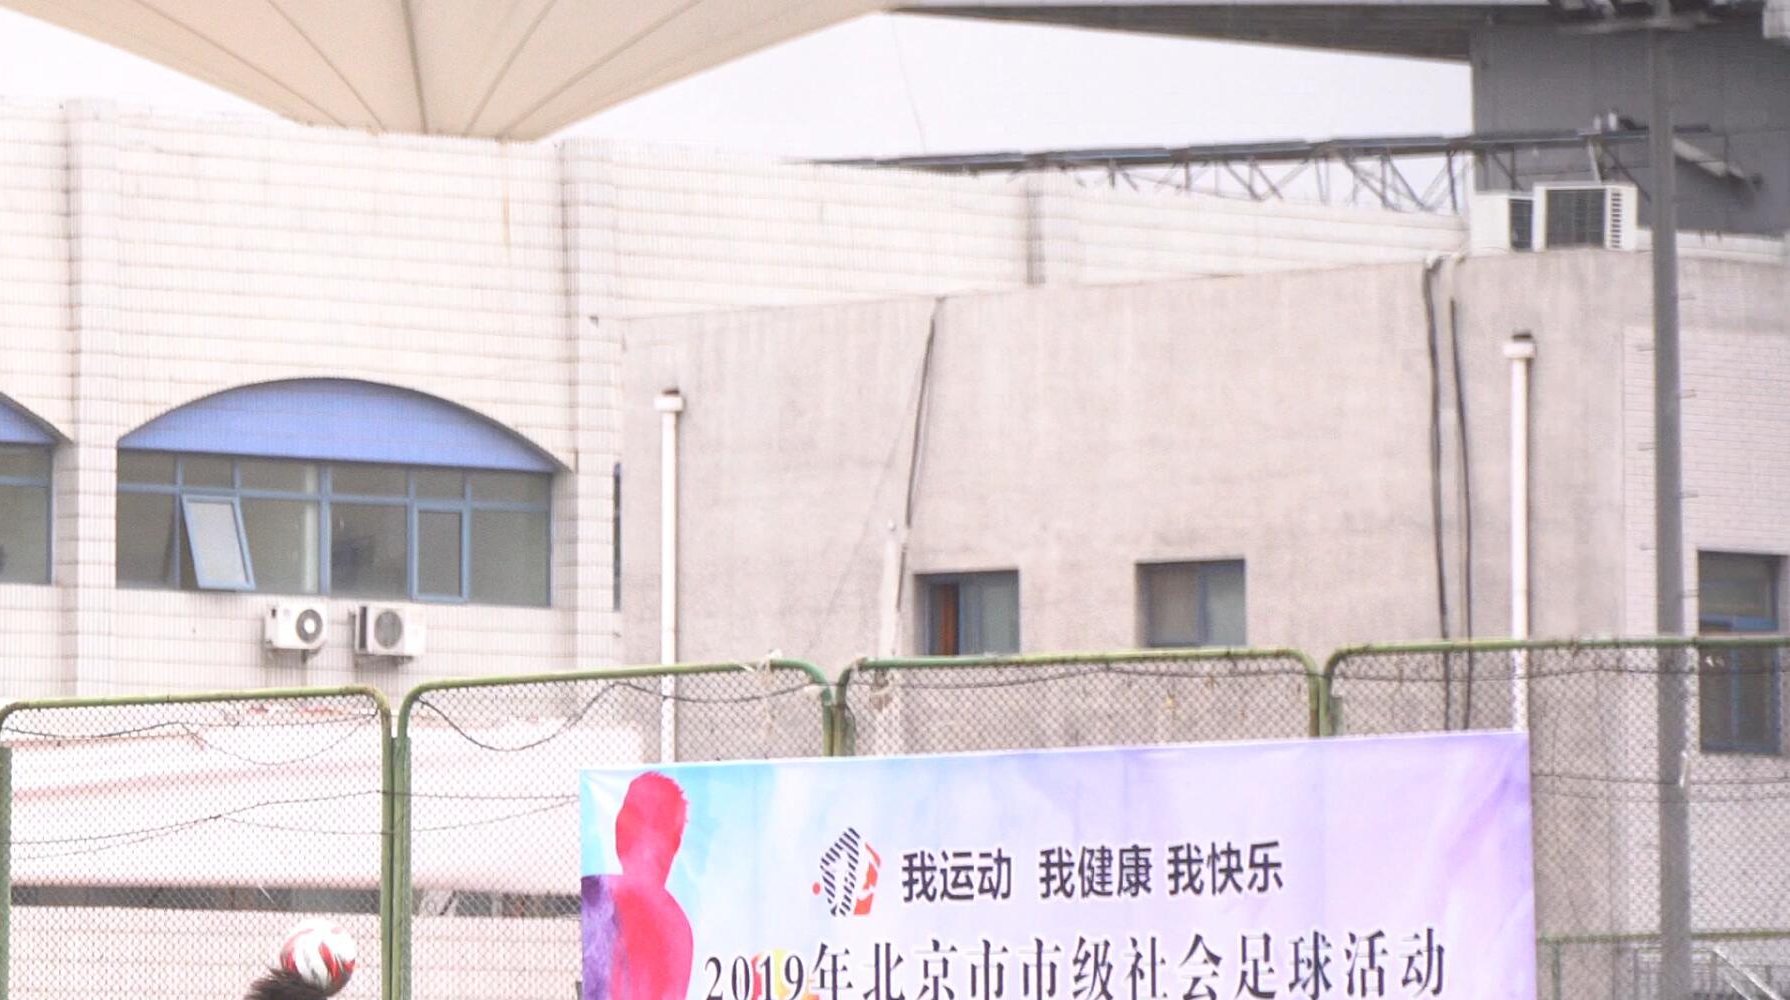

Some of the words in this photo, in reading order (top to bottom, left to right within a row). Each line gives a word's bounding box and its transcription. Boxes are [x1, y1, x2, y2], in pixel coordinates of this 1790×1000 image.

[902, 847, 1012, 902] 我运动
[1039, 844, 1153, 899] 我健康
[1167, 841, 1284, 896] 我快乐
